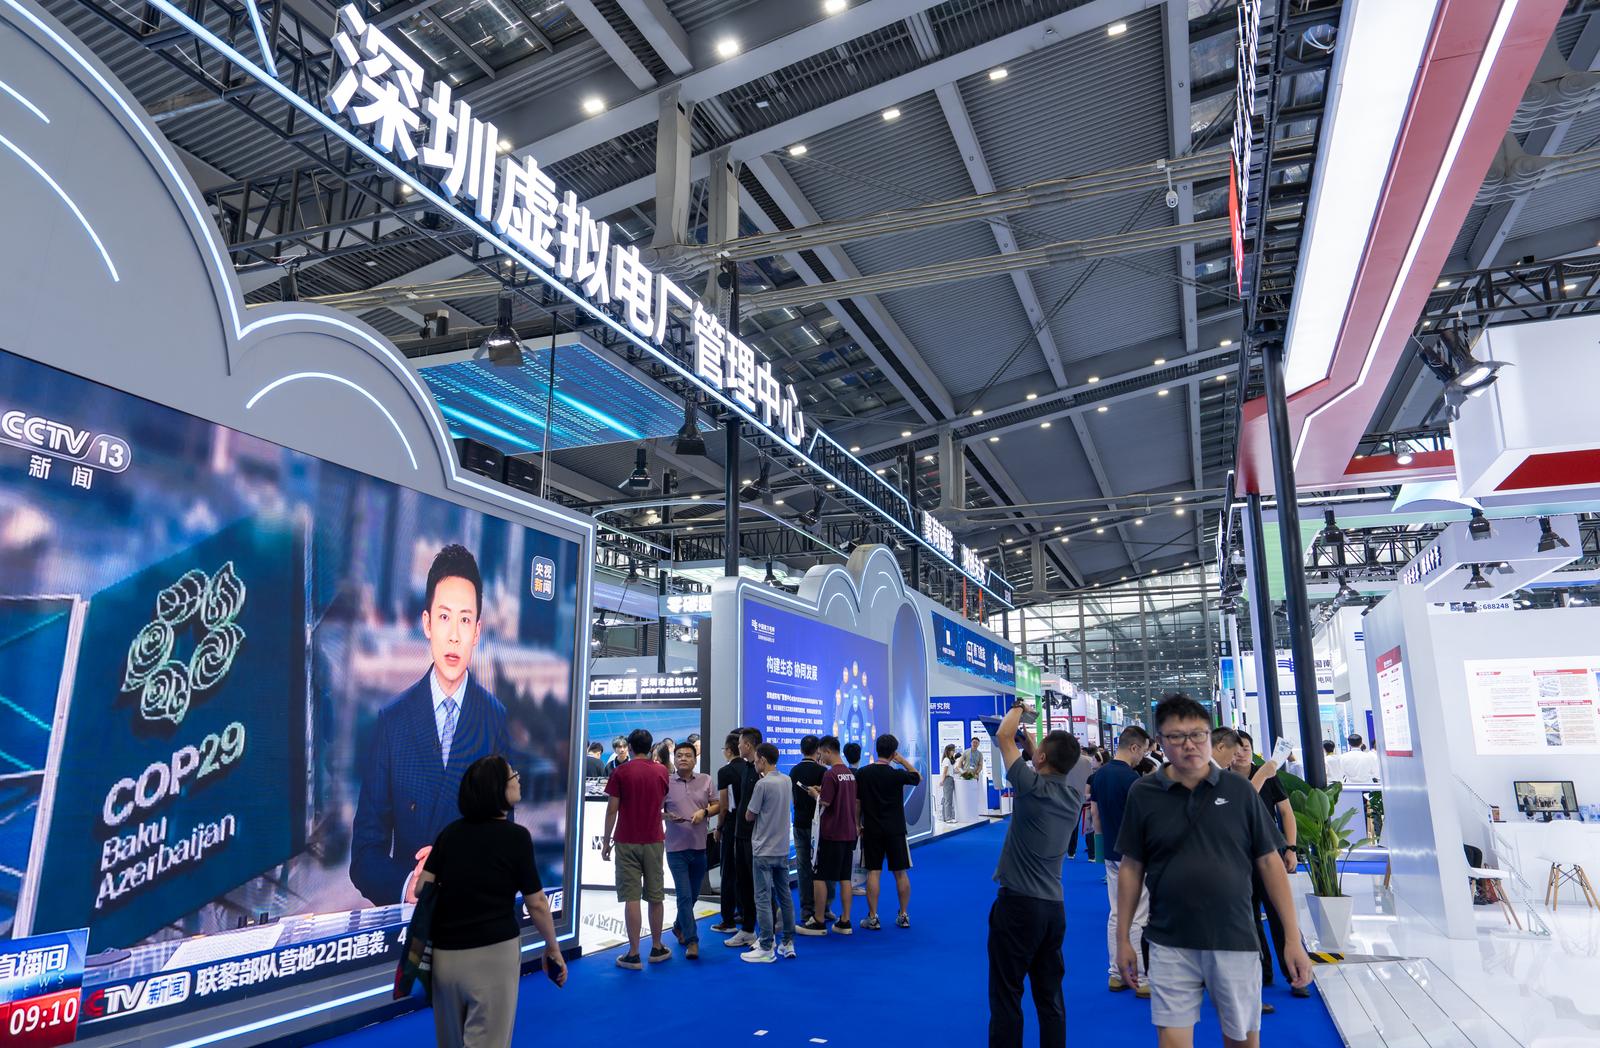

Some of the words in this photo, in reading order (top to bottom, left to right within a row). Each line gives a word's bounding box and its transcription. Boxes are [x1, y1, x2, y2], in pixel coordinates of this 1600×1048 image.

[325, 2, 805, 446] 深圳虚拟电厂管理中心
[1, 410, 91, 454] CCTV
[98, 440, 124, 467] 13
[28, 454, 94, 490] 新闻
[640, 677, 698, 687] 深圳市虚拟电厂
[766, 655, 793, 677] 构建生态
[794, 661, 818, 681] 协同发展
[103, 721, 246, 826] COP29
[95, 814, 236, 909] Azerbaijan
[100, 816, 167, 871] Baku
[148, 975, 187, 1005] 新闻
[9, 997, 78, 1035] 09:10
